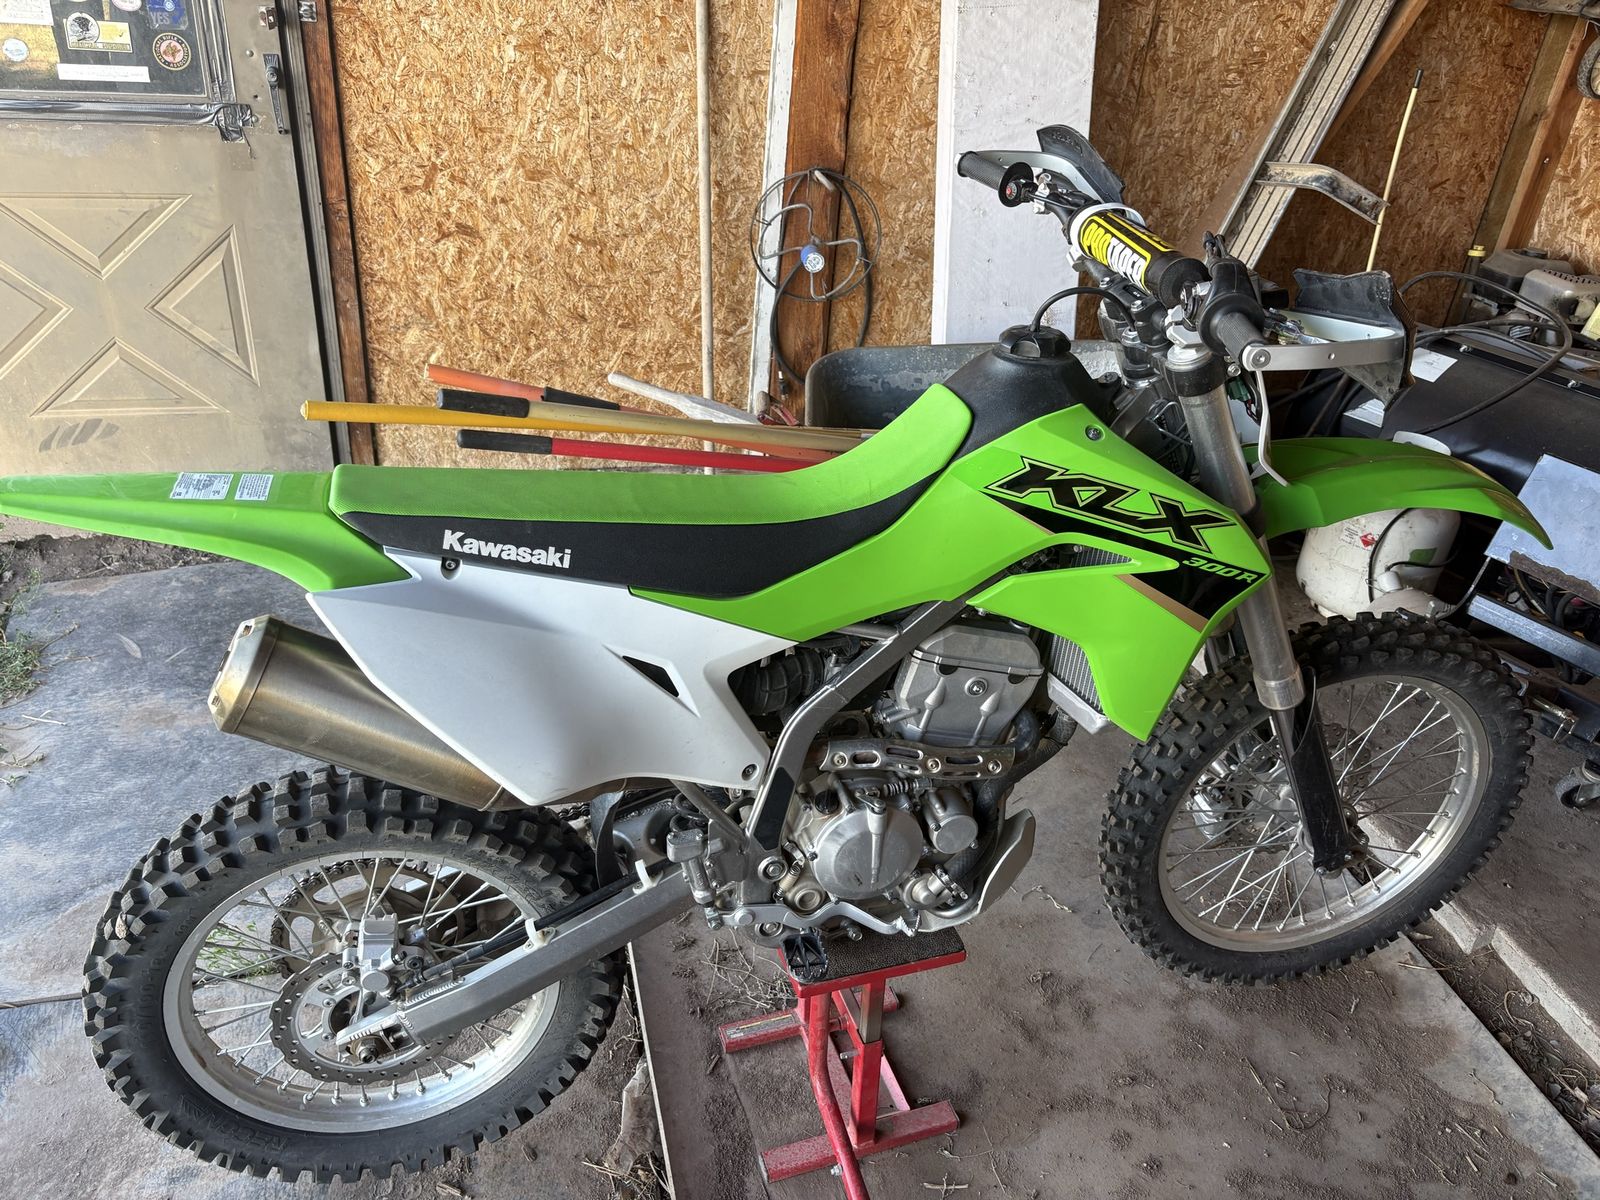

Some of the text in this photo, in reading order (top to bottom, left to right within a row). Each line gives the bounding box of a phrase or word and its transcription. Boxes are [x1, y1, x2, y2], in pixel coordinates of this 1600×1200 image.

[150, 11, 170, 25] YES
[984, 455, 1237, 554] KLX
[442, 529, 572, 569] Kawasaki
[1182, 556, 1259, 584] 300R
